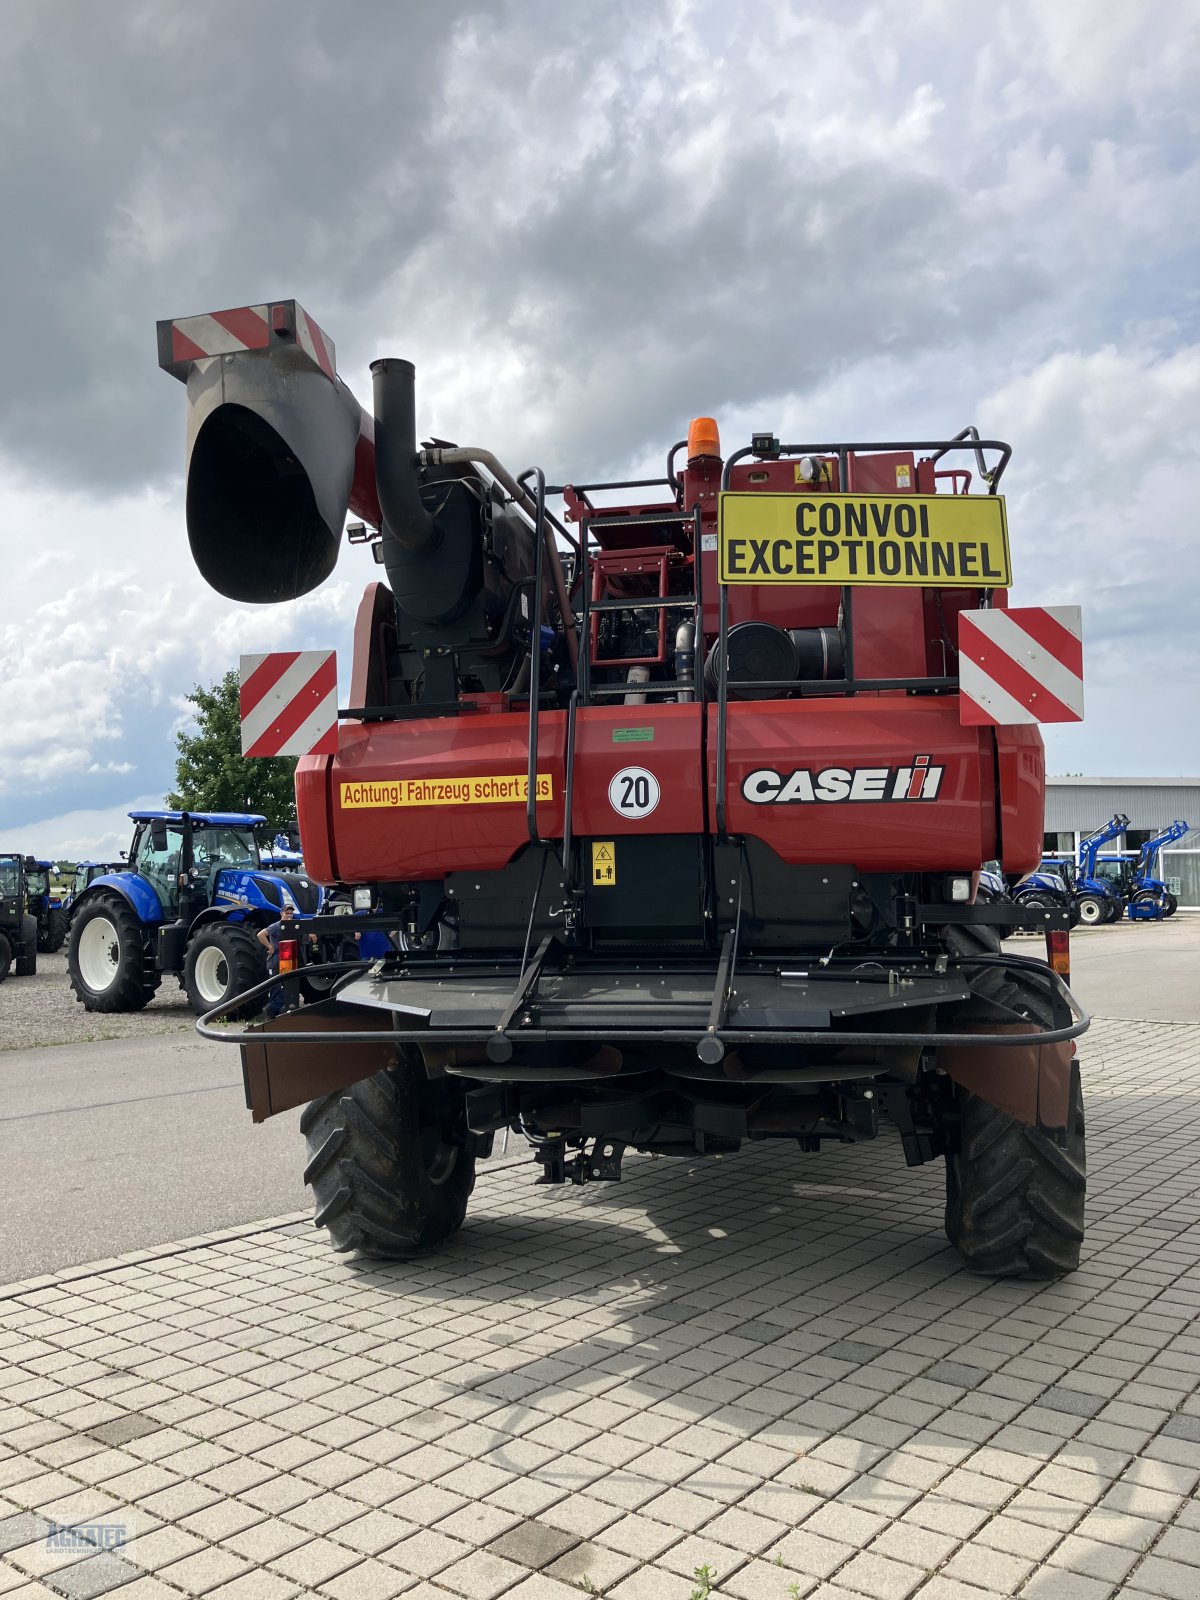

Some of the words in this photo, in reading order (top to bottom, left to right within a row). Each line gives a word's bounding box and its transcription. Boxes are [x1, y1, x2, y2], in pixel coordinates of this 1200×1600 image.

[795, 501, 930, 538] CONVOI
[727, 539, 1002, 577] EXCEPTIONNEL
[344, 783, 403, 805] Achtung!
[407, 780, 470, 802] Fahrzeug
[474, 778, 520, 798] schert
[620, 775, 649, 808] 20
[743, 768, 889, 803] CASE
